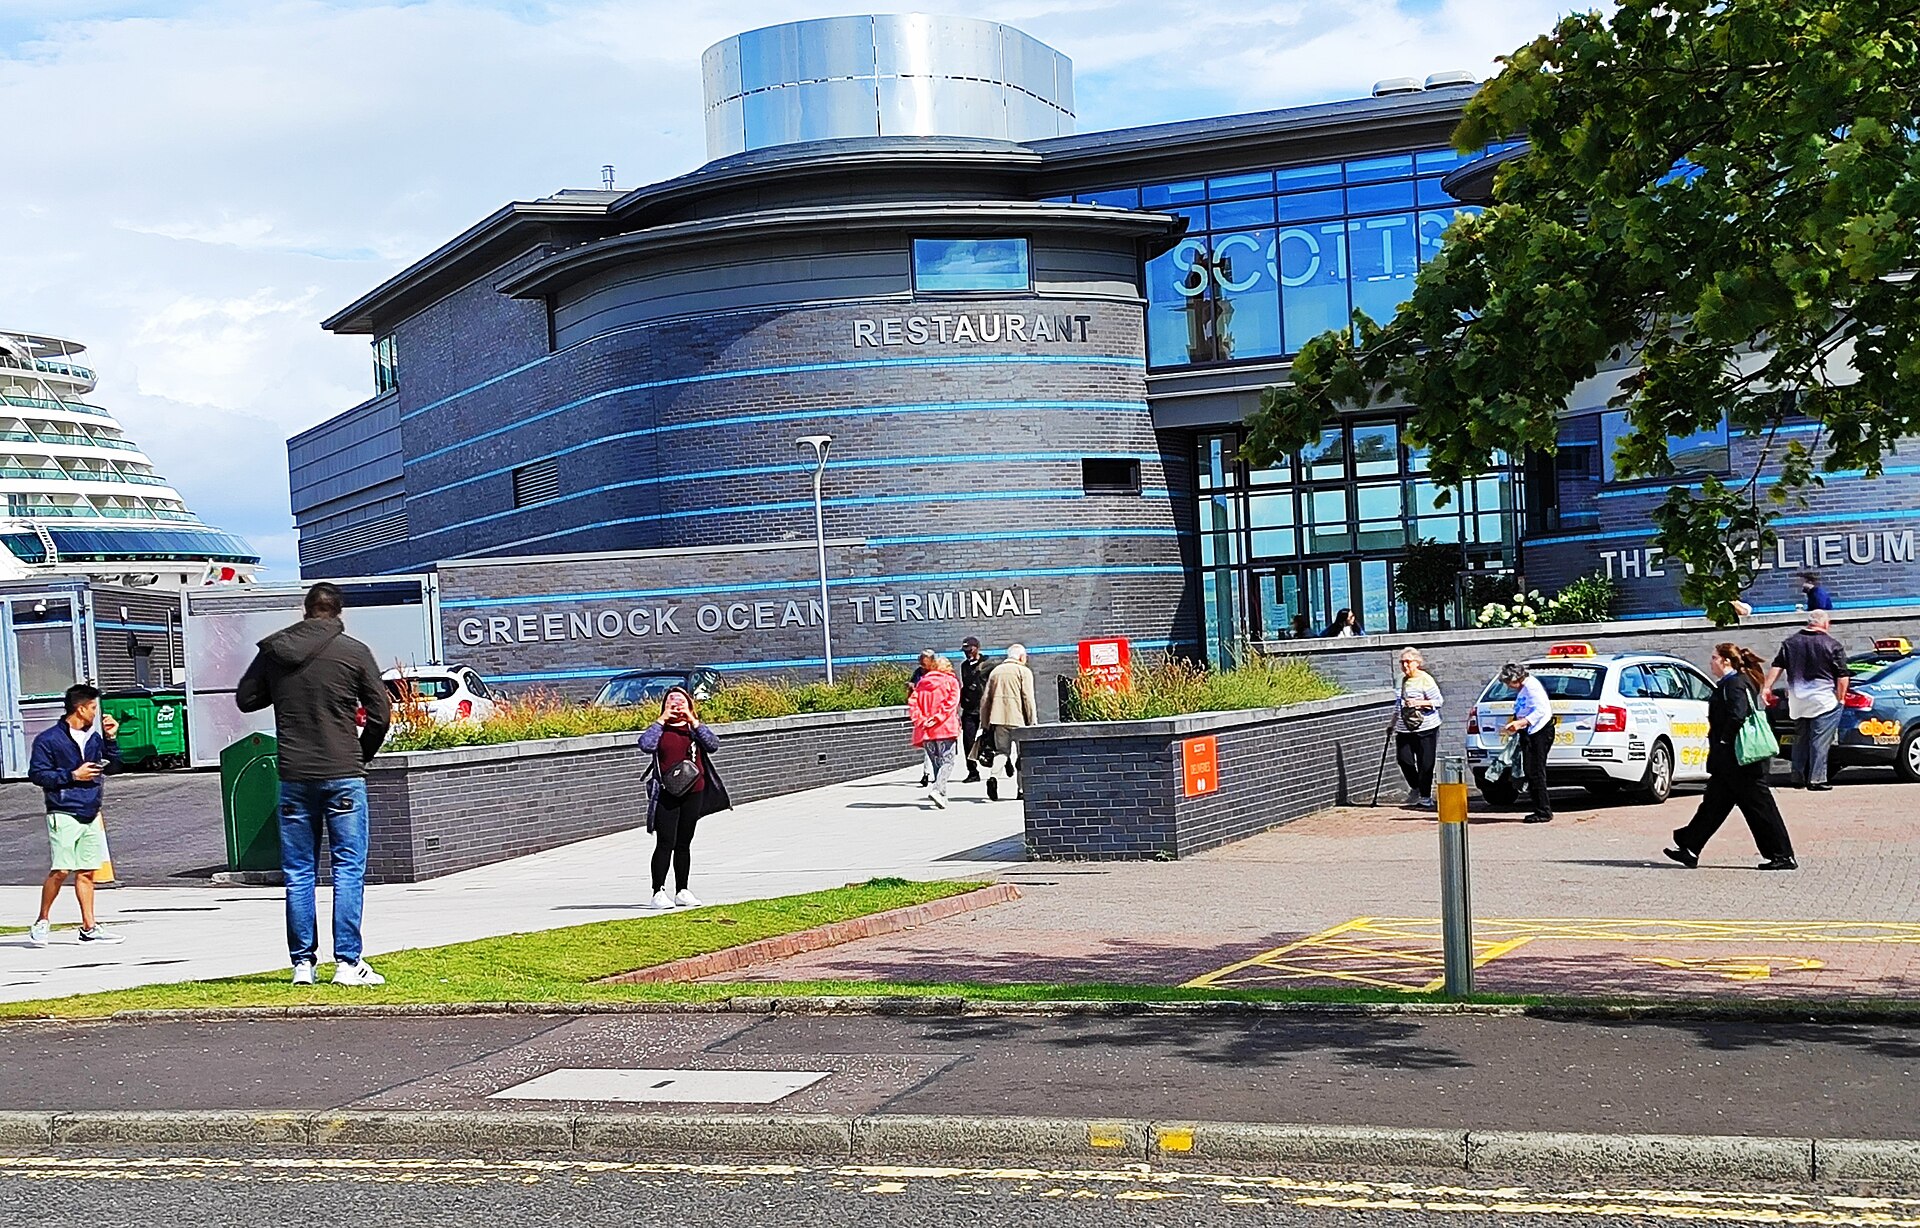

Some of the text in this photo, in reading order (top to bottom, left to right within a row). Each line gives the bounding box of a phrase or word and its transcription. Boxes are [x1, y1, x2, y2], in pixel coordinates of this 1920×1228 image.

[853, 314, 1091, 347] RESTAURANT
[1600, 530, 1915, 582] THE YLLIEUM
[457, 588, 1042, 645] GREENOCK OCEAN TERMINAL
[1551, 645, 1587, 655] TAXI
